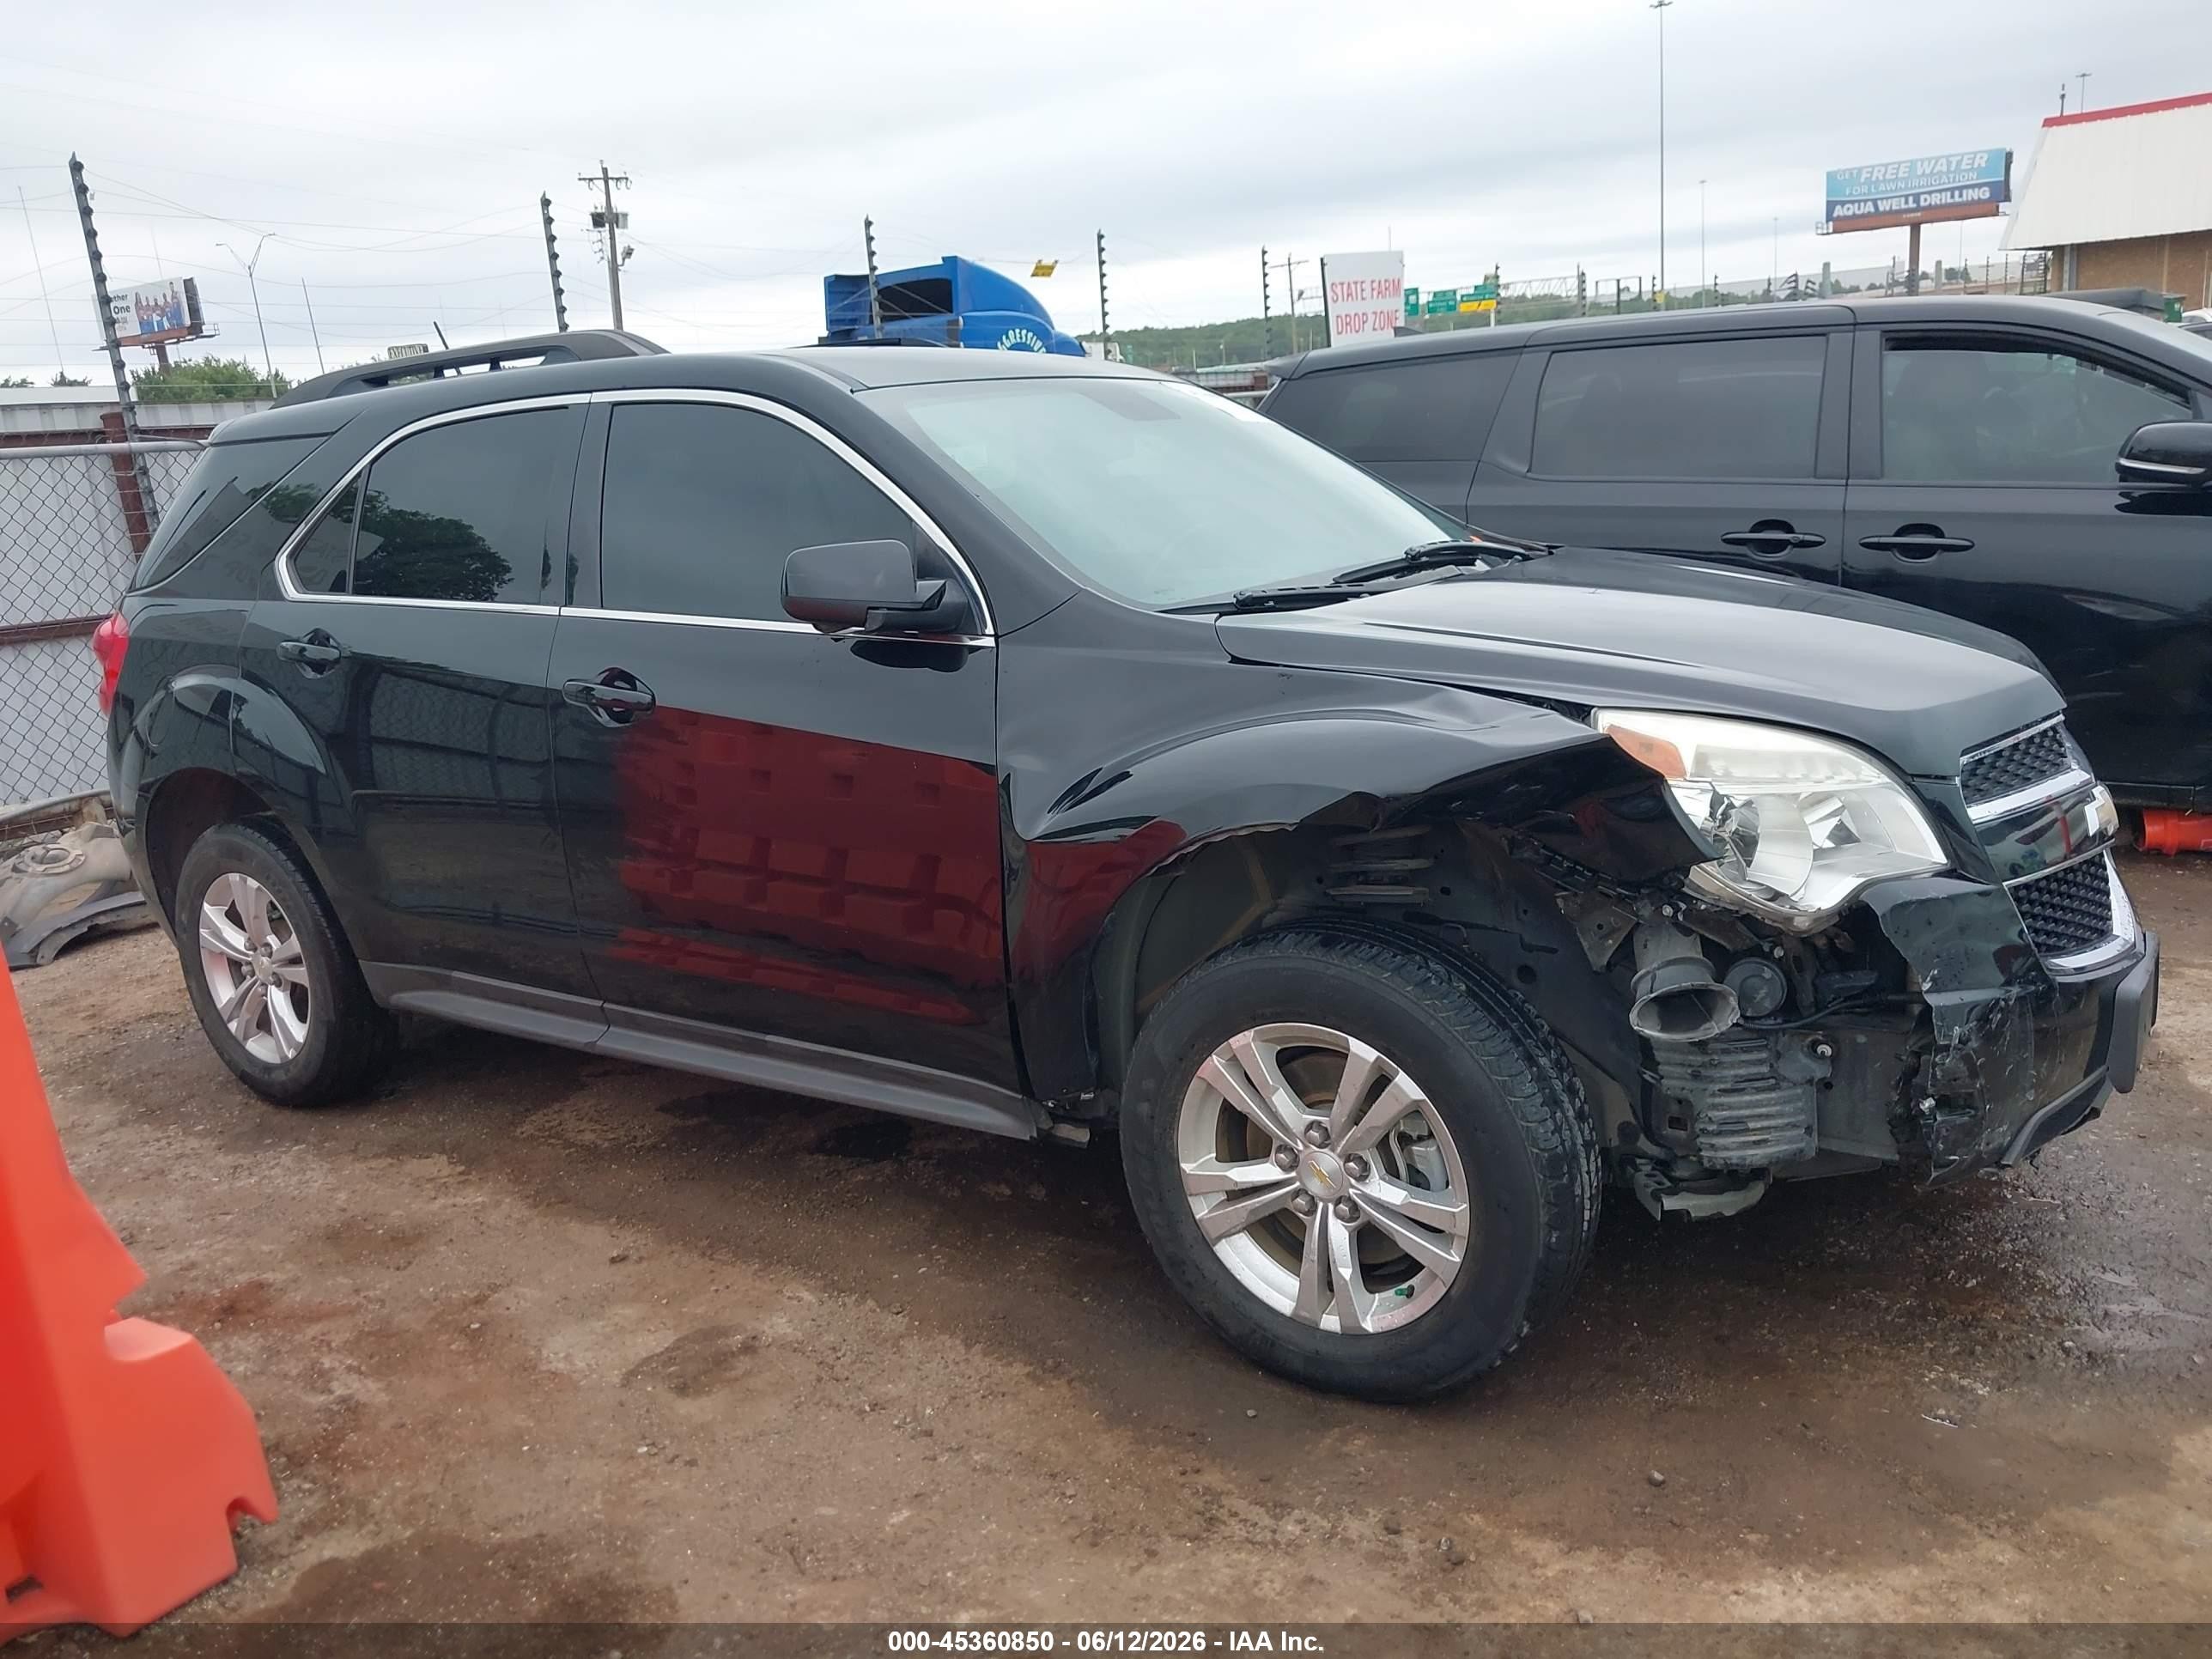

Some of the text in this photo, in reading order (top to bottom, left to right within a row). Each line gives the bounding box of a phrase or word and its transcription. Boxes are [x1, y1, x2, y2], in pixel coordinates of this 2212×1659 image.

[1837, 151, 1989, 183] GET FREE WATER
[1845, 172, 1978, 197] FOR LAWN IRRIGATION
[1833, 186, 1990, 217] AQUA WELL DRILLING
[1330, 276, 1401, 303] STATE FARM
[113, 305, 131, 314] One
[1335, 309, 1400, 335] DROP ZONE
